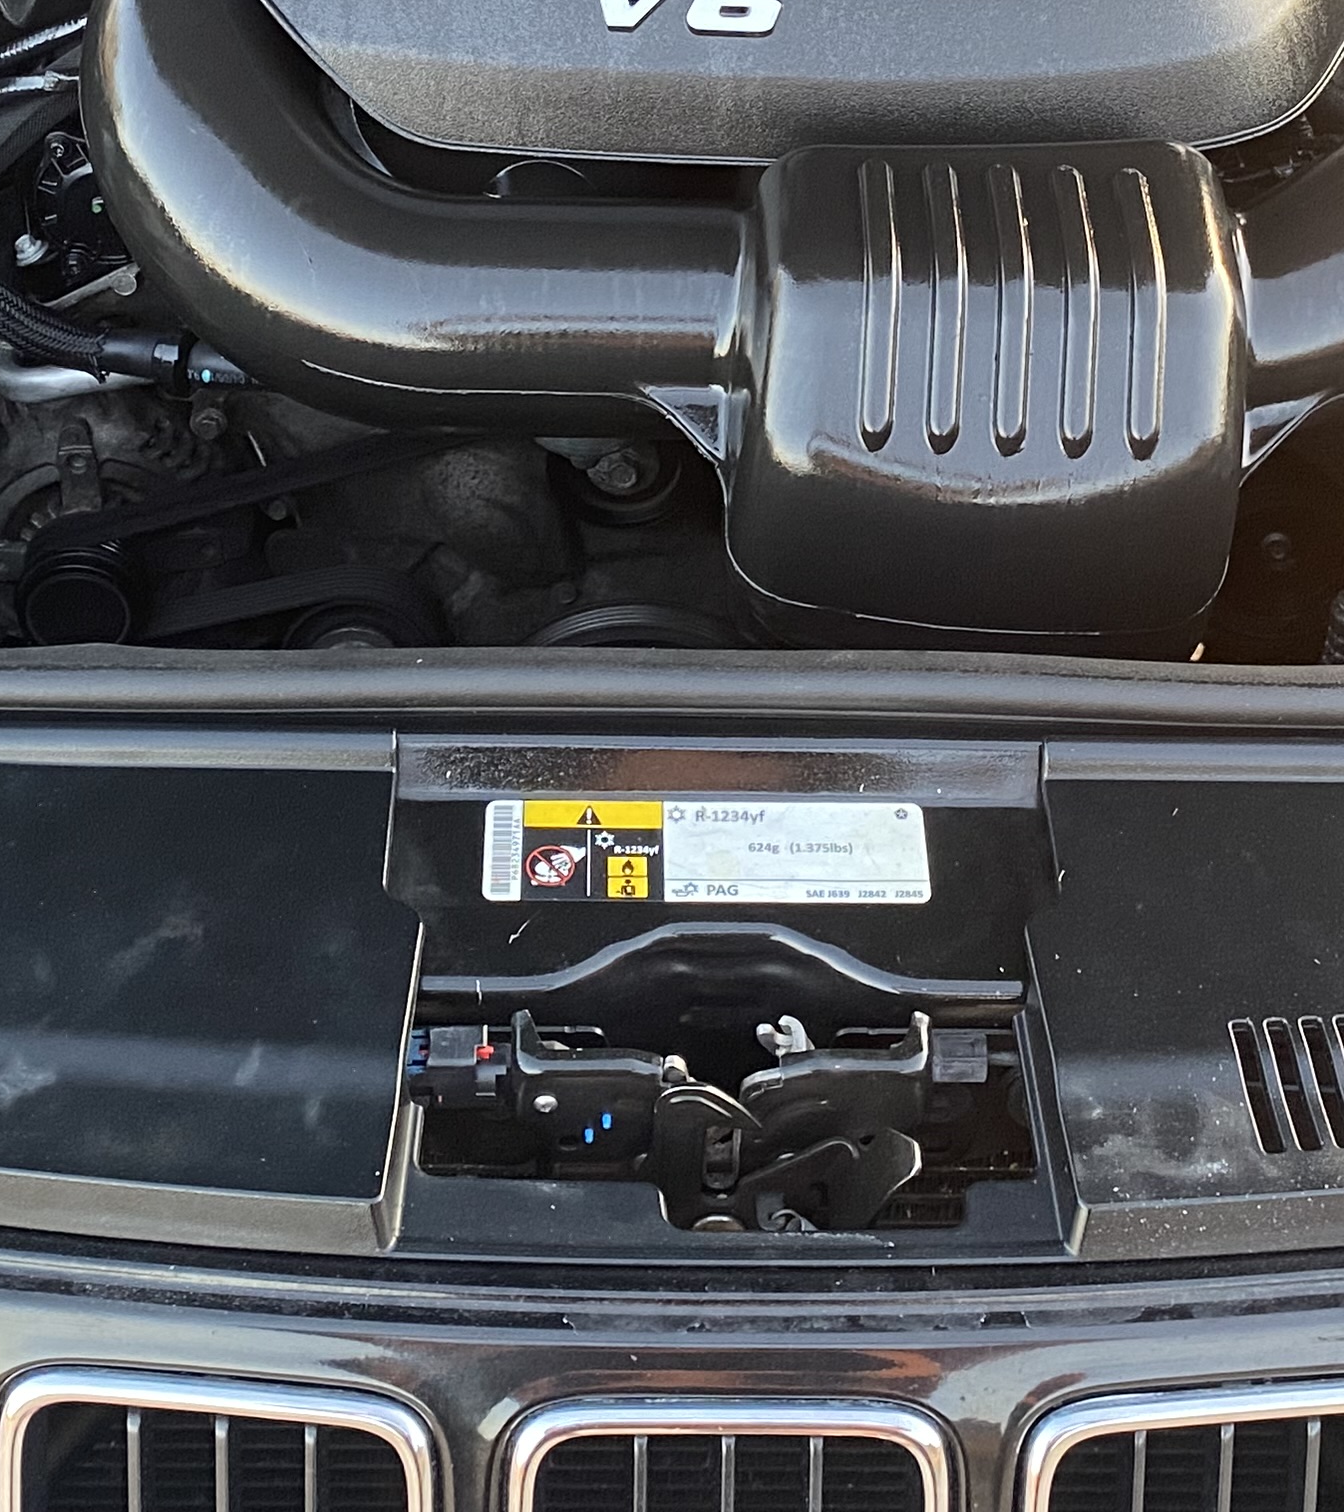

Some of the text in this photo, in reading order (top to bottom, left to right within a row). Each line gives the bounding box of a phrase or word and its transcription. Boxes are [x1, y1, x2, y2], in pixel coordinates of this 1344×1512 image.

[694, 809, 766, 825] R-1234yf
[748, 842, 853, 855] 624g (1.375lbs)
[706, 884, 739, 897] PAG
